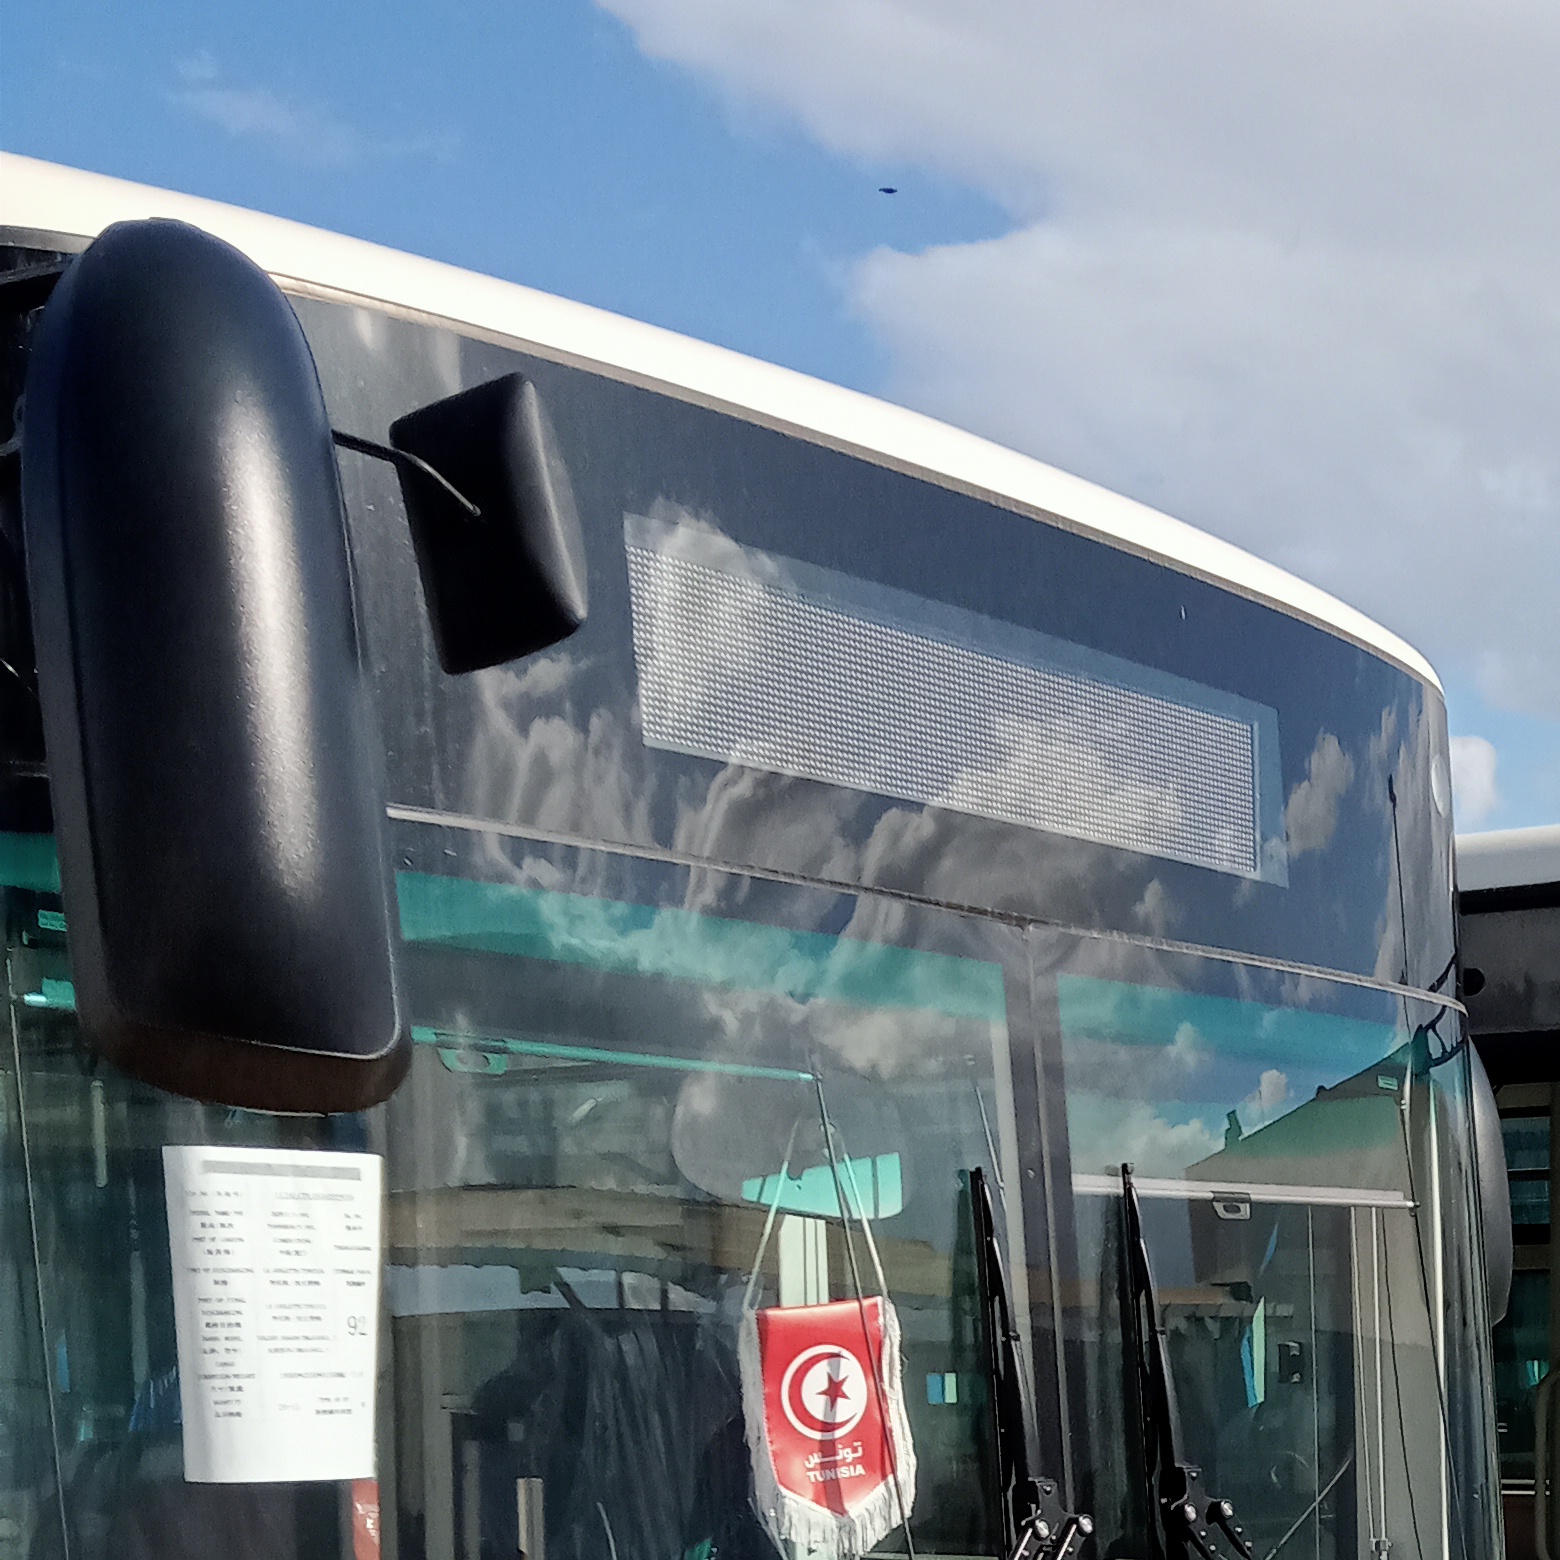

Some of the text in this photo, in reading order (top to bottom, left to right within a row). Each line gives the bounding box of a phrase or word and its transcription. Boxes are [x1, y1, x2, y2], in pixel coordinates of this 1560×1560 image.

[347, 1316, 368, 1336] 92
[804, 1441, 863, 1469] تونس
[806, 1464, 866, 1482] TUNISIA
